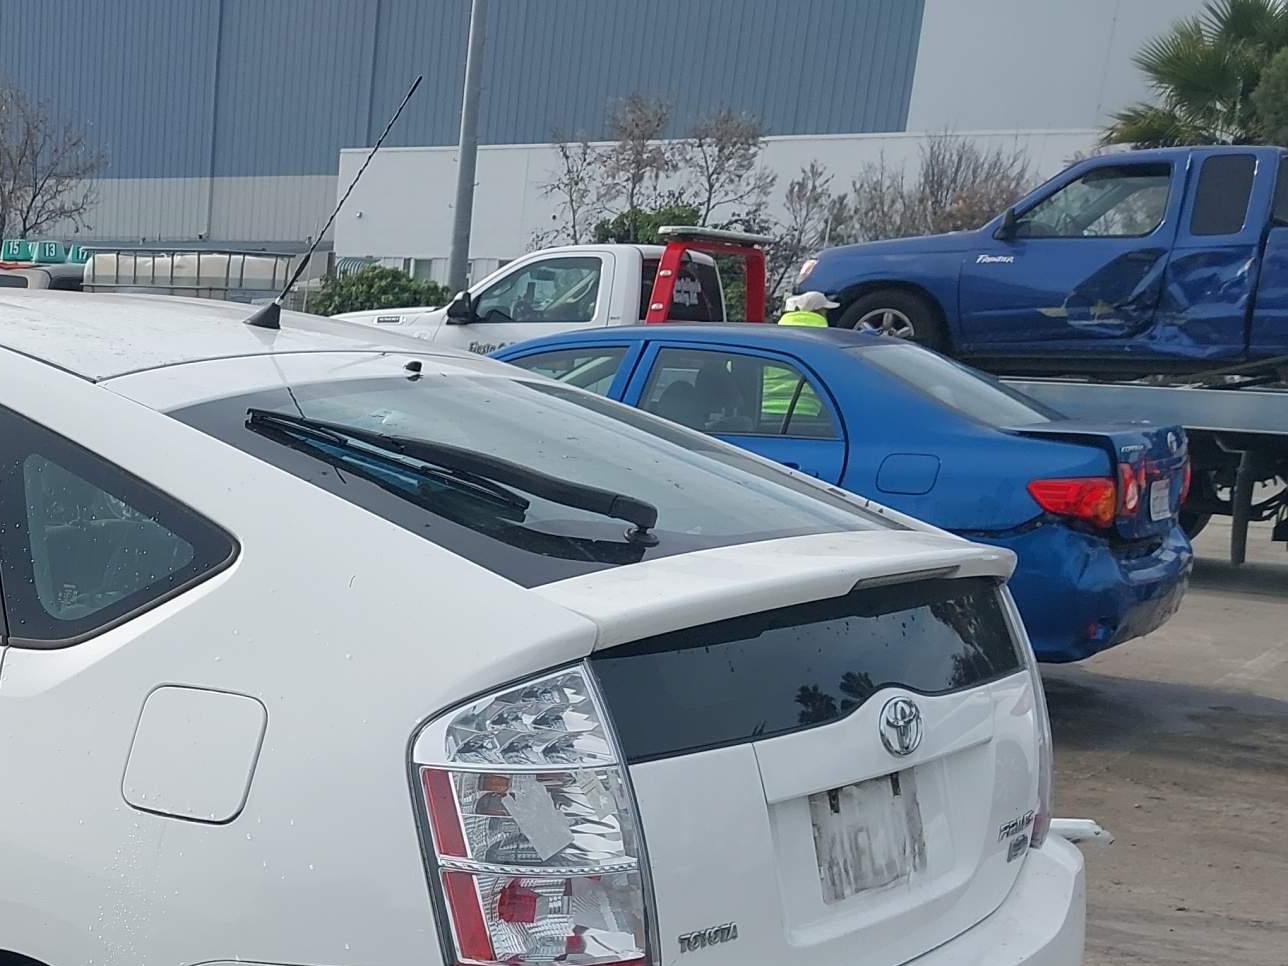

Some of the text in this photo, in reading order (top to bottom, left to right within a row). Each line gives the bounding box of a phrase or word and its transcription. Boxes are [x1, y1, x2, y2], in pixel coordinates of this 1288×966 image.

[9, 241, 20, 255] 15
[45, 243, 56, 257] 13
[678, 921, 739, 954] TOYOTA
